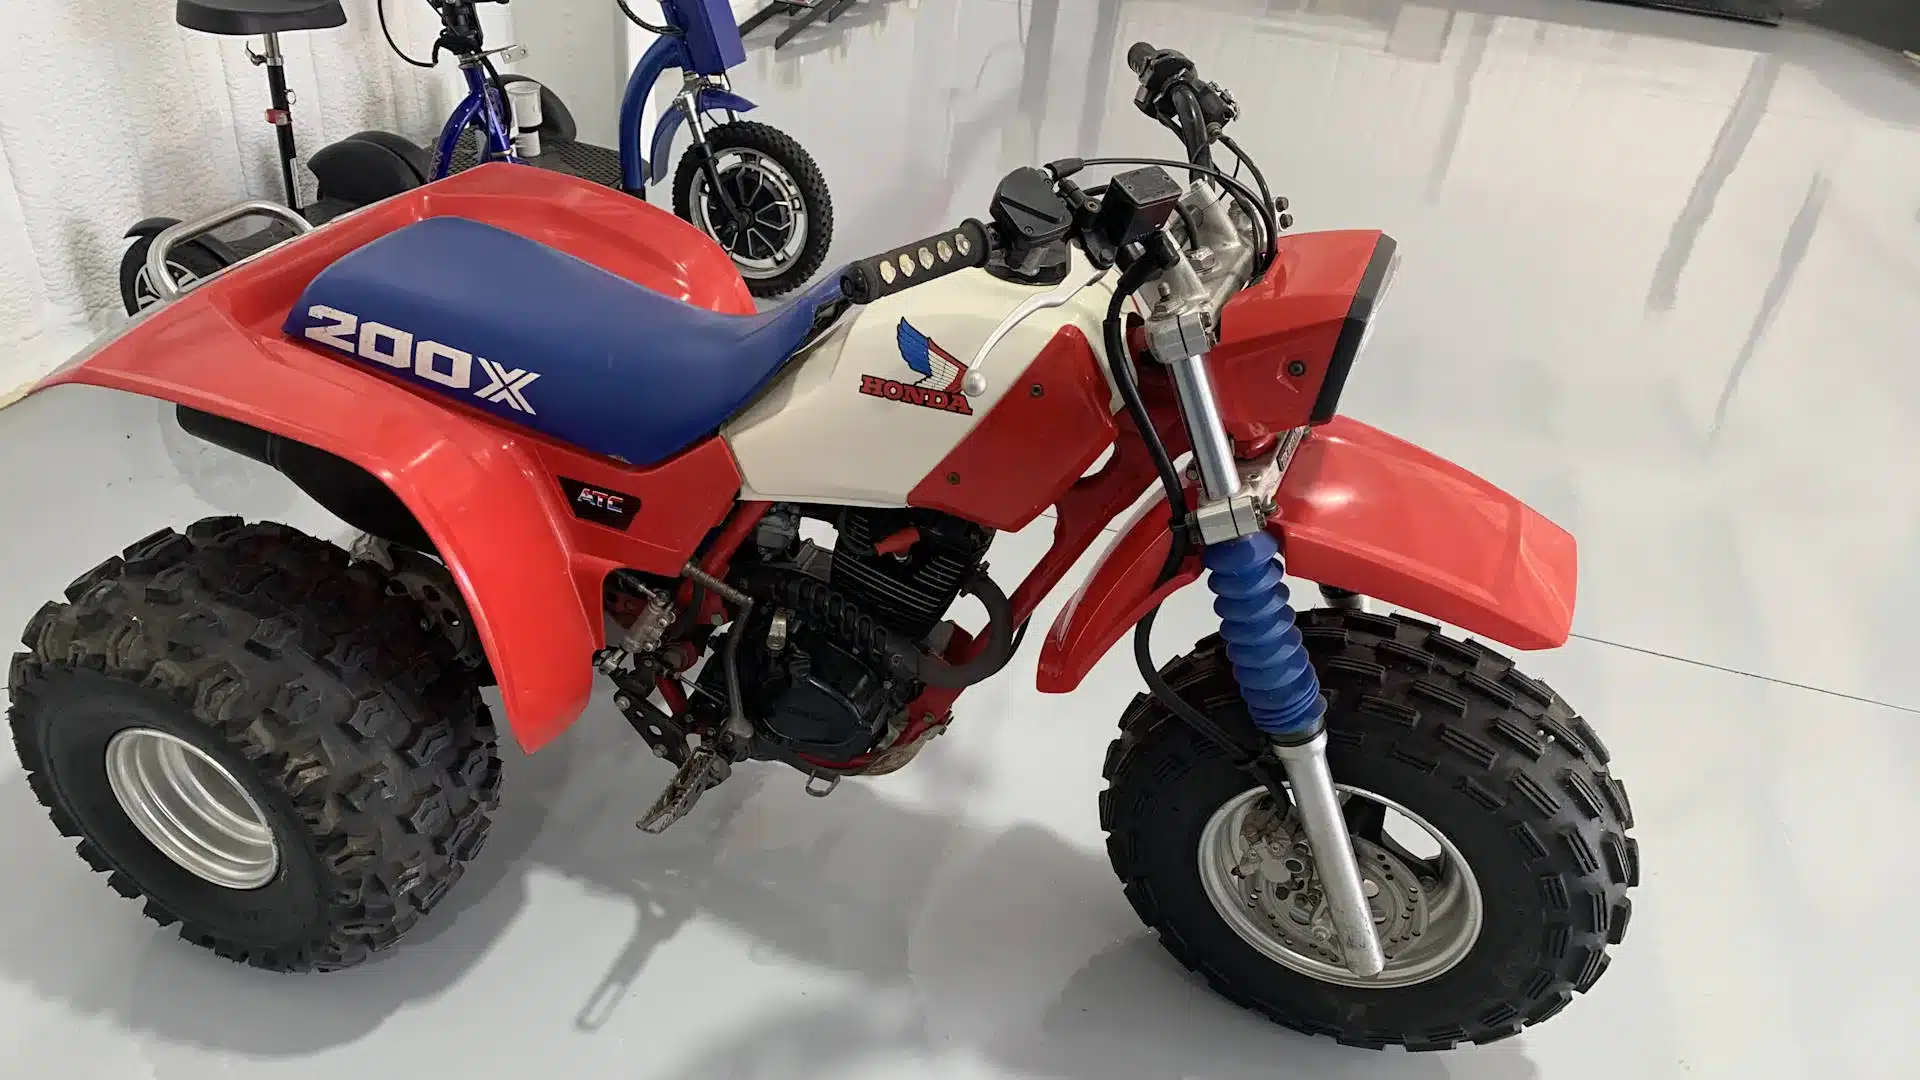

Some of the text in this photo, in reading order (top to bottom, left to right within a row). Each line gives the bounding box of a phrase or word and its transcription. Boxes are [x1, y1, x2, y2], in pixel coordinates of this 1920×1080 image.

[305, 305, 541, 416] 200X
[859, 374, 973, 416] HONDA
[577, 488, 624, 513] ATC
